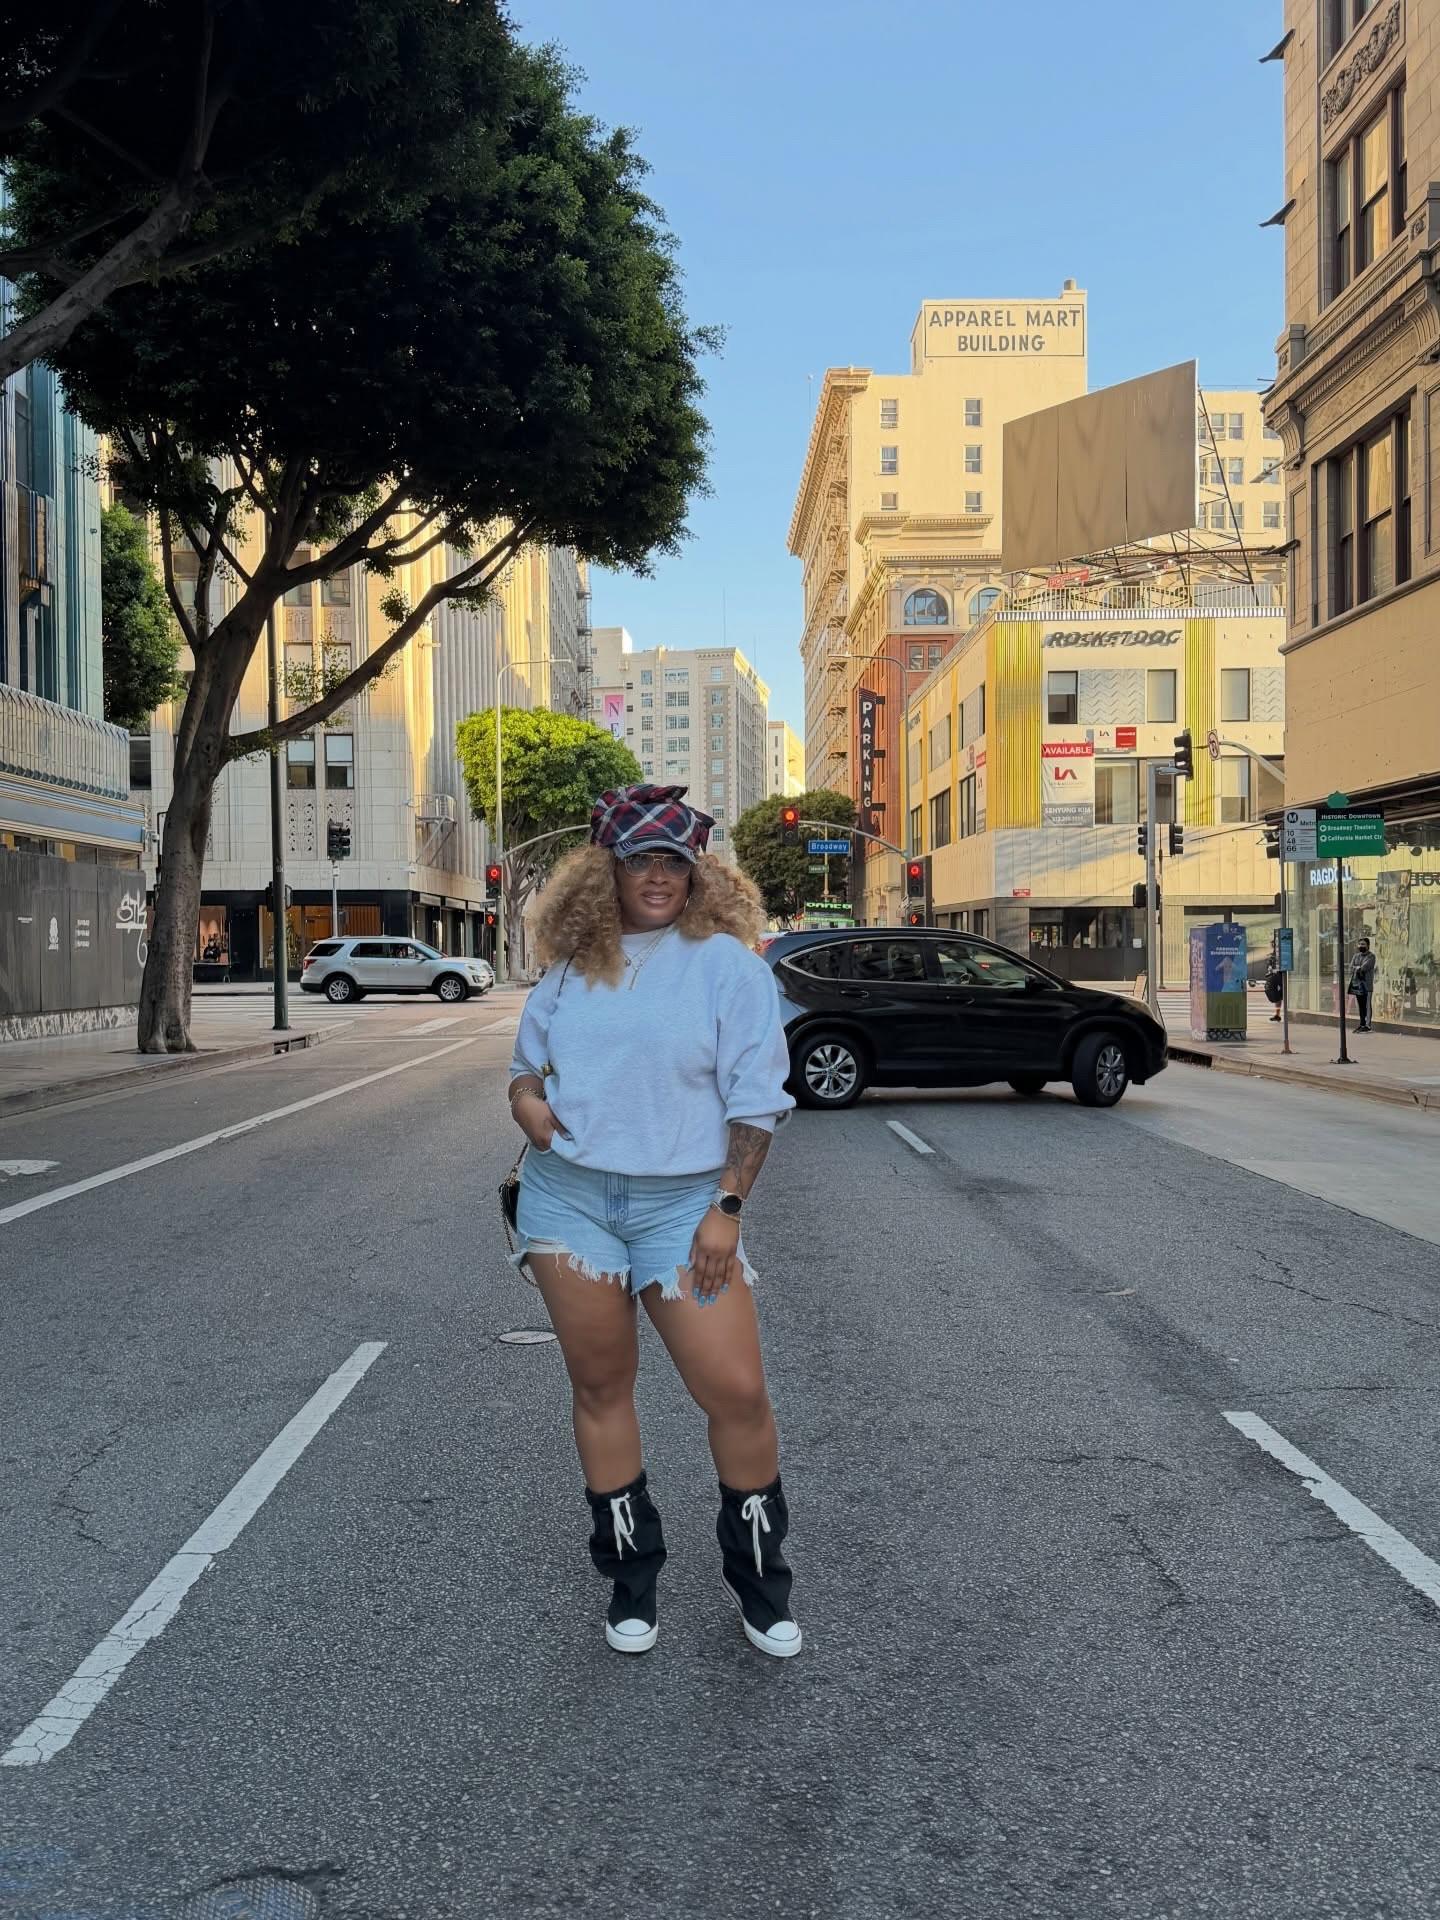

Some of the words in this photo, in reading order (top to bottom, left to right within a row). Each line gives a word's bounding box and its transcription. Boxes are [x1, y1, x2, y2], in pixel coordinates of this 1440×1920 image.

[929, 310, 1016, 327] APPAREL
[1026, 309, 1081, 327] MART
[958, 334, 1046, 352] BUILDING
[862, 701, 873, 808] PARKING
[1044, 746, 1092, 754] AVAILABLE
[1310, 866, 1352, 886] RAGDOL
